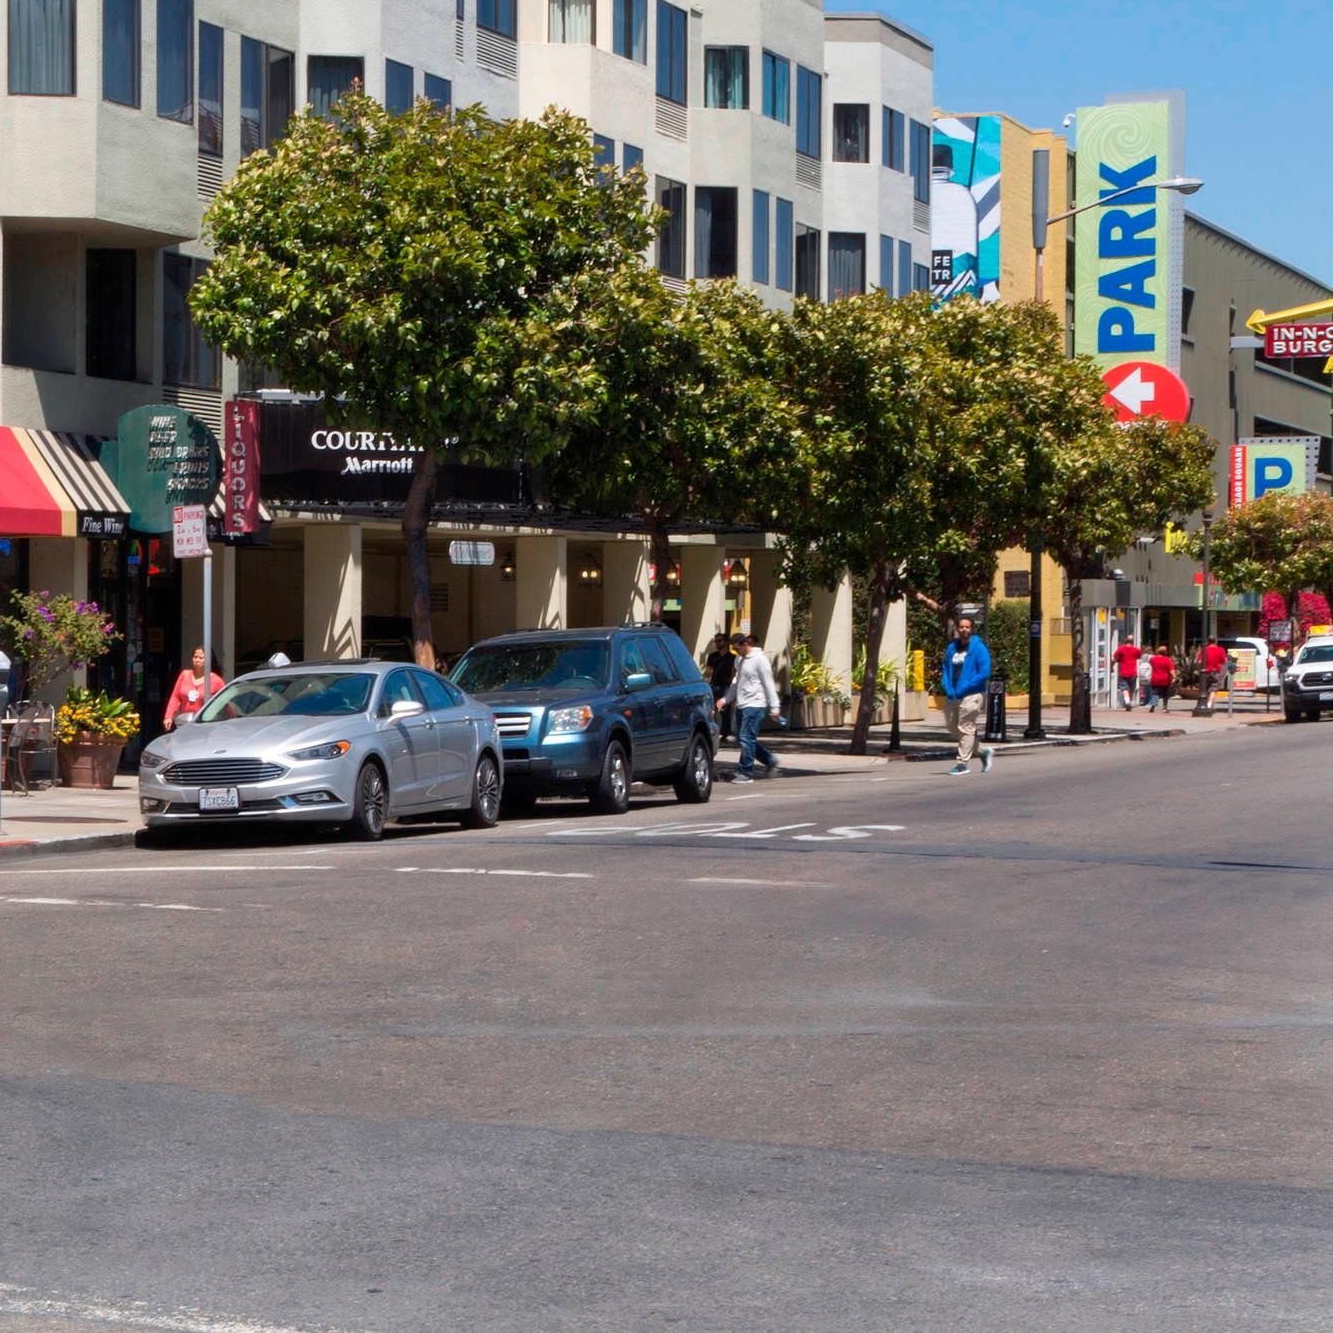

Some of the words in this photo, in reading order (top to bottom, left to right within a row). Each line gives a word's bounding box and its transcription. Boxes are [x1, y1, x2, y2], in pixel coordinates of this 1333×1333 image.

[1098, 155, 1156, 354] PARK
[231, 406, 246, 528] LIQUORS
[341, 456, 414, 475] Marriott
[1254, 457, 1293, 499] P
[81, 516, 103, 533] Fine
